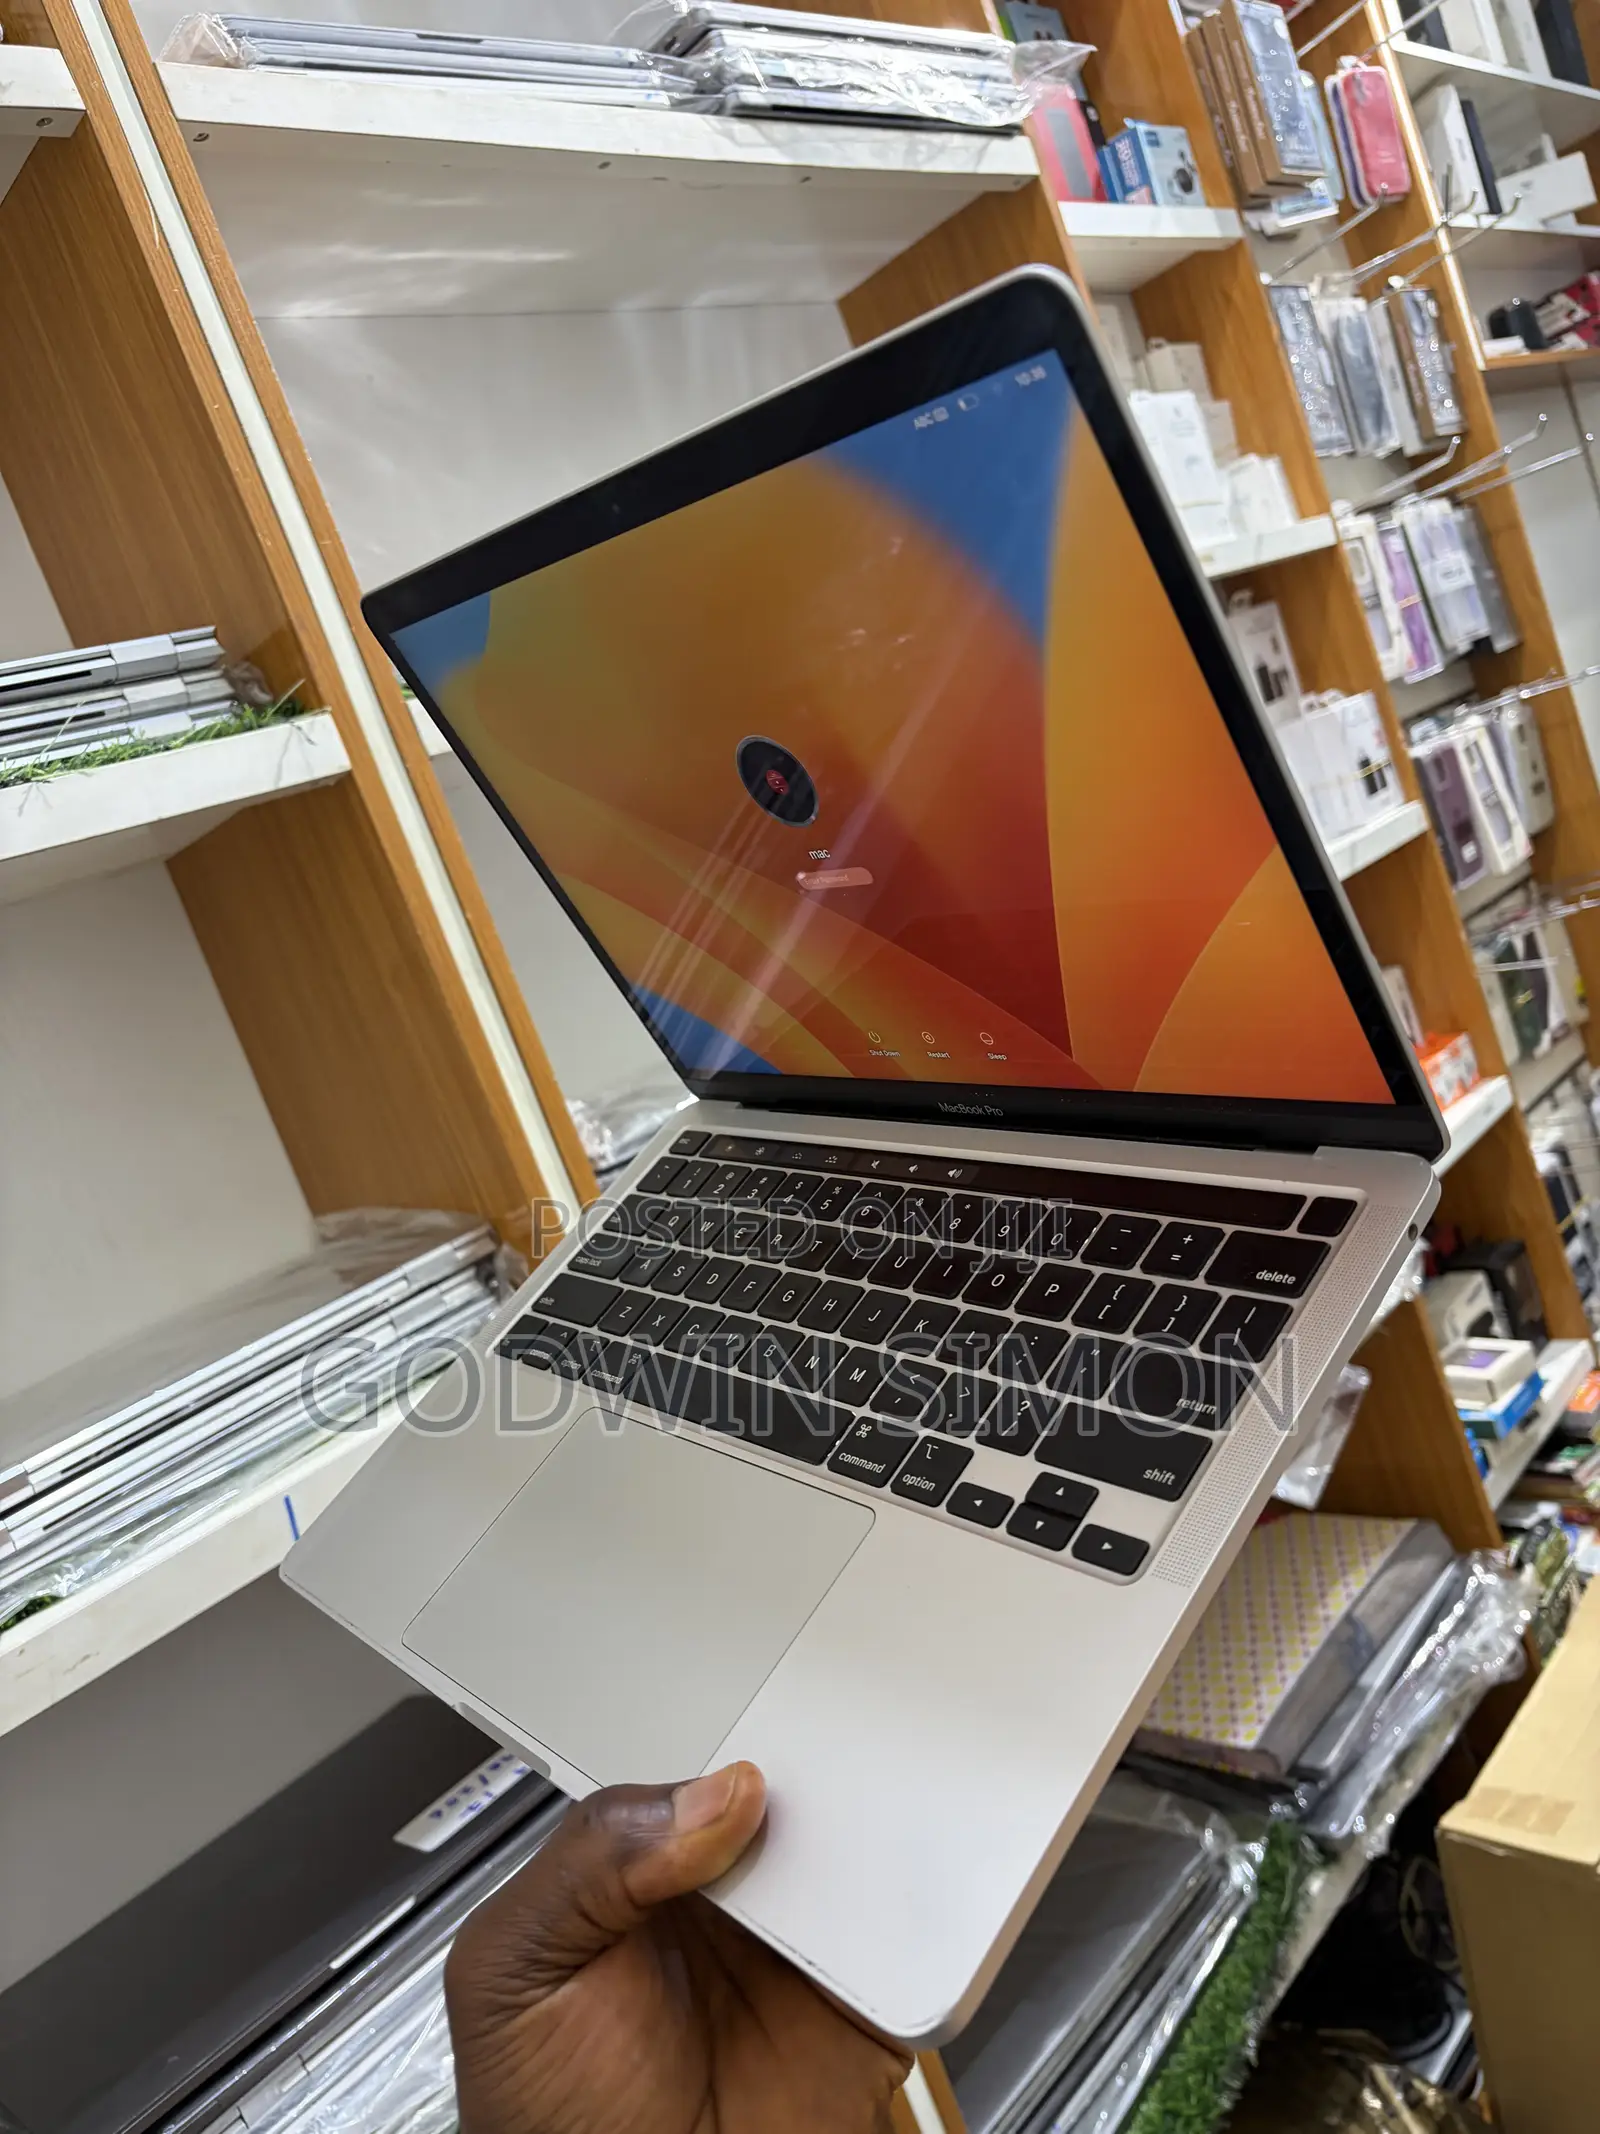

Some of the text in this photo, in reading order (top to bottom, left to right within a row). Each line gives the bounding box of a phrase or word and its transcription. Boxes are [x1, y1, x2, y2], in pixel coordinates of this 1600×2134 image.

[808, 849, 831, 860] mac
[927, 1051, 950, 1059] Restart
[987, 1053, 1007, 1061] Sleep
[937, 1102, 1004, 1117] MacBook Pro
[713, 1184, 725, 1194] 2
[747, 1188, 759, 1199] 3
[783, 1194, 794, 1204] 4
[820, 1199, 832, 1210] 5
[861, 1205, 872, 1216] 6
[949, 1217, 962, 1229] 8
[998, 1225, 1010, 1238] 9
[1255, 1269, 1296, 1285] delete
[668, 1215, 680, 1227] Q
[700, 1221, 715, 1232] W
[734, 1228, 747, 1239] E
[770, 1234, 783, 1245] R
[810, 1241, 823, 1252] T
[852, 1248, 864, 1260] Y
[894, 1256, 908, 1268] U
[991, 1274, 1005, 1287] O
[1044, 1283, 1059, 1296] P
[640, 1259, 1217, 1415] A S D F G H J K L return
[590, 1369, 624, 1384] command
[619, 1306, 1176, 1486] Z X C V B N M shift
[838, 1452, 886, 1474] command
[902, 1473, 936, 1492] option
